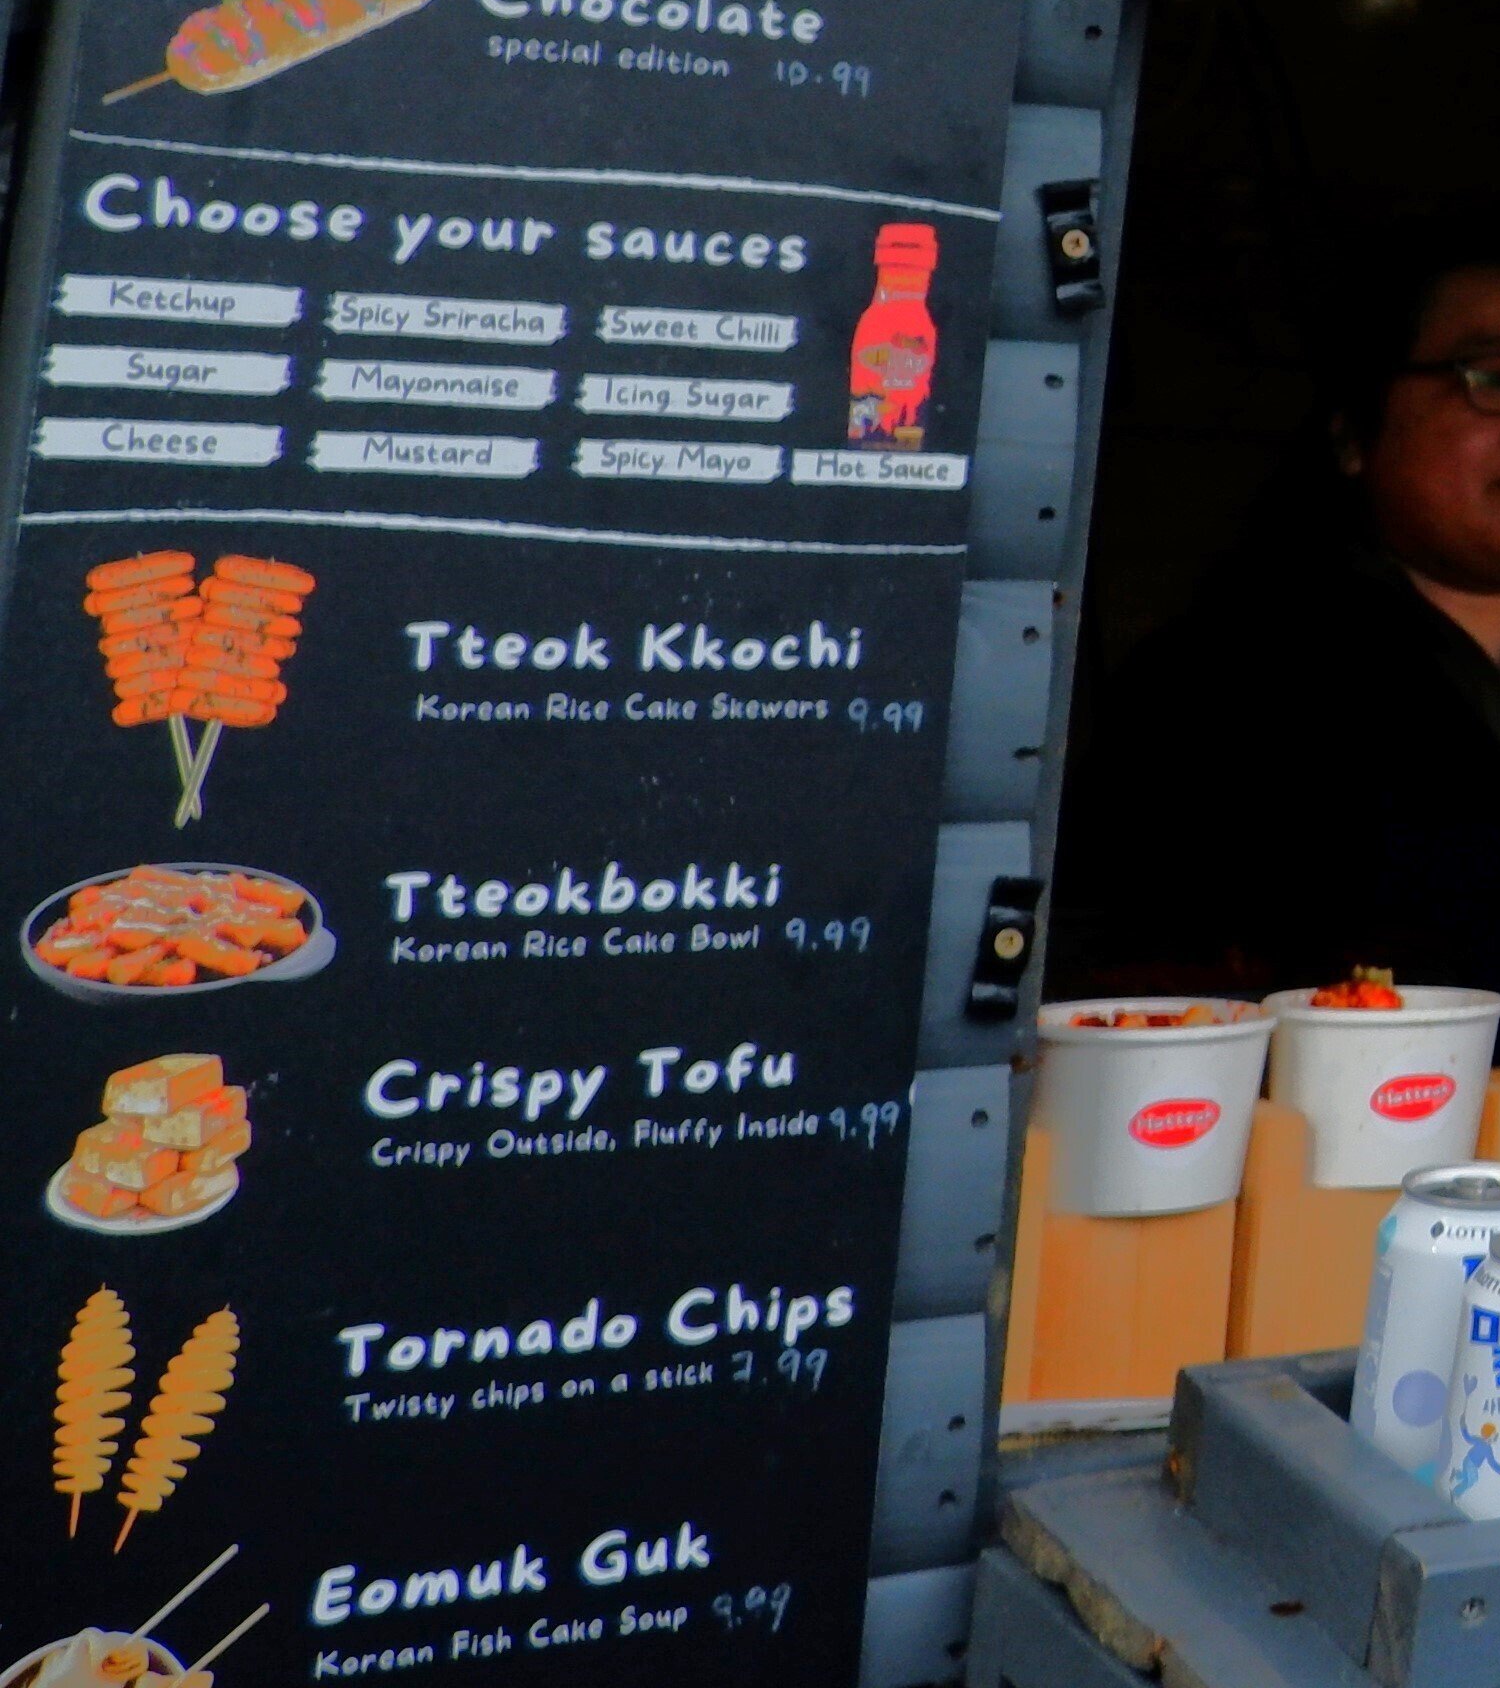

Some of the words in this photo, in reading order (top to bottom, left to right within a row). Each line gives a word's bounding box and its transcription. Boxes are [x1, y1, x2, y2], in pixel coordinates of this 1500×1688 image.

[488, 33, 601, 69] special
[618, 46, 730, 78] edition
[776, 59, 871, 99] 10.99
[84, 173, 363, 243] Choose
[397, 212, 555, 265] your
[586, 220, 808, 272] sauces
[108, 283, 236, 318] Ketchup
[340, 301, 420, 335] Spicy
[427, 301, 545, 335] Sriracha
[609, 310, 699, 342] Sweet
[716, 313, 781, 345] Chilli
[125, 355, 217, 390] Sugar
[351, 366, 519, 406] Mayonnaise
[603, 383, 672, 417] Icing
[685, 385, 770, 417] Sugar
[100, 426, 217, 457] Cheese
[363, 437, 492, 467] Mustard
[600, 444, 666, 475] Spicy
[678, 447, 752, 479] Mayo
[815, 452, 864, 481] Hot
[878, 457, 949, 485] Sauce
[405, 620, 610, 673] Tteok
[640, 621, 863, 673] Kkochi
[416, 692, 531, 722] Korean
[546, 693, 610, 722] Rice
[626, 693, 697, 722] Cake
[711, 693, 829, 722] Skewers
[847, 699, 925, 736] 9.99
[385, 863, 782, 922] Tteokbokki
[393, 933, 513, 966] Korean
[523, 931, 585, 960] Rice
[603, 927, 676, 957] Cake
[690, 924, 760, 953] Bowl
[783, 916, 872, 956] 9.99
[364, 1057, 607, 1120] Crispy
[639, 1041, 797, 1098] Tofu
[370, 1135, 471, 1169] Crispy
[488, 1124, 618, 1159] Outside,
[633, 1116, 723, 1150] Fluffy
[737, 1110, 819, 1140] Inside
[337, 1298, 638, 1376] Tornado
[668, 1284, 856, 1347] Chips
[345, 1388, 456, 1425] Twisty
[470, 1380, 546, 1413] chips
[561, 1375, 597, 1399] on
[611, 1372, 629, 1392] a
[643, 1358, 715, 1388] stick
[311, 1544, 547, 1627] Eomuk
[580, 1520, 711, 1586] Guk
[315, 1642, 435, 1681] Korean
[451, 1626, 511, 1659] Fish
[528, 1615, 603, 1649] Cake
[619, 1604, 688, 1636] Soup
